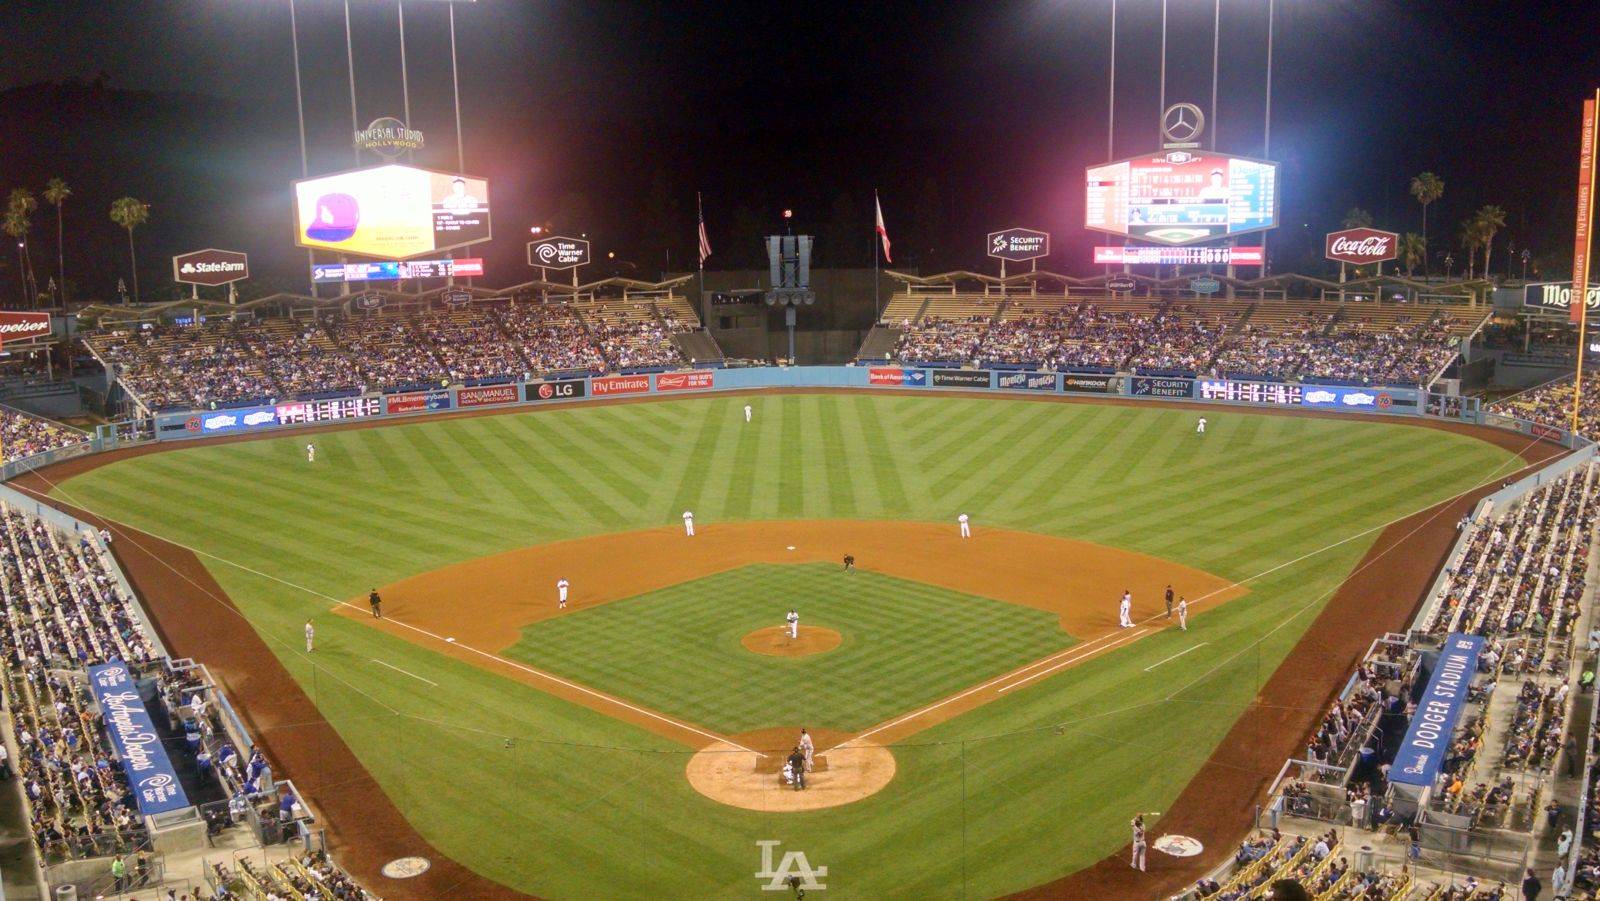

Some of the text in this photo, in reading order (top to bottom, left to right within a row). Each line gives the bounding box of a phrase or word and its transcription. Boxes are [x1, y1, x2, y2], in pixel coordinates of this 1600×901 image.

[354, 127, 424, 143] UNIVERSAL STUDIOS
[365, 140, 417, 148] HOLLYWOOD
[1010, 236, 1044, 244] SECURITY
[1331, 236, 1391, 256] Coca-Cola
[556, 384, 573, 396] LG
[592, 380, 608, 393] Fly
[609, 377, 649, 391] Emirates
[1151, 387, 1185, 396] BENEFIT
[1152, 379, 1189, 388] SECURITY
[460, 388, 515, 400] SAN MANUEL
[1412, 701, 1451, 749] DODGER
[1433, 655, 1469, 698] STADIUM
[109, 705, 145, 737] Angeles
[122, 733, 157, 771] Dodgers
[754, 840, 828, 891] LA
